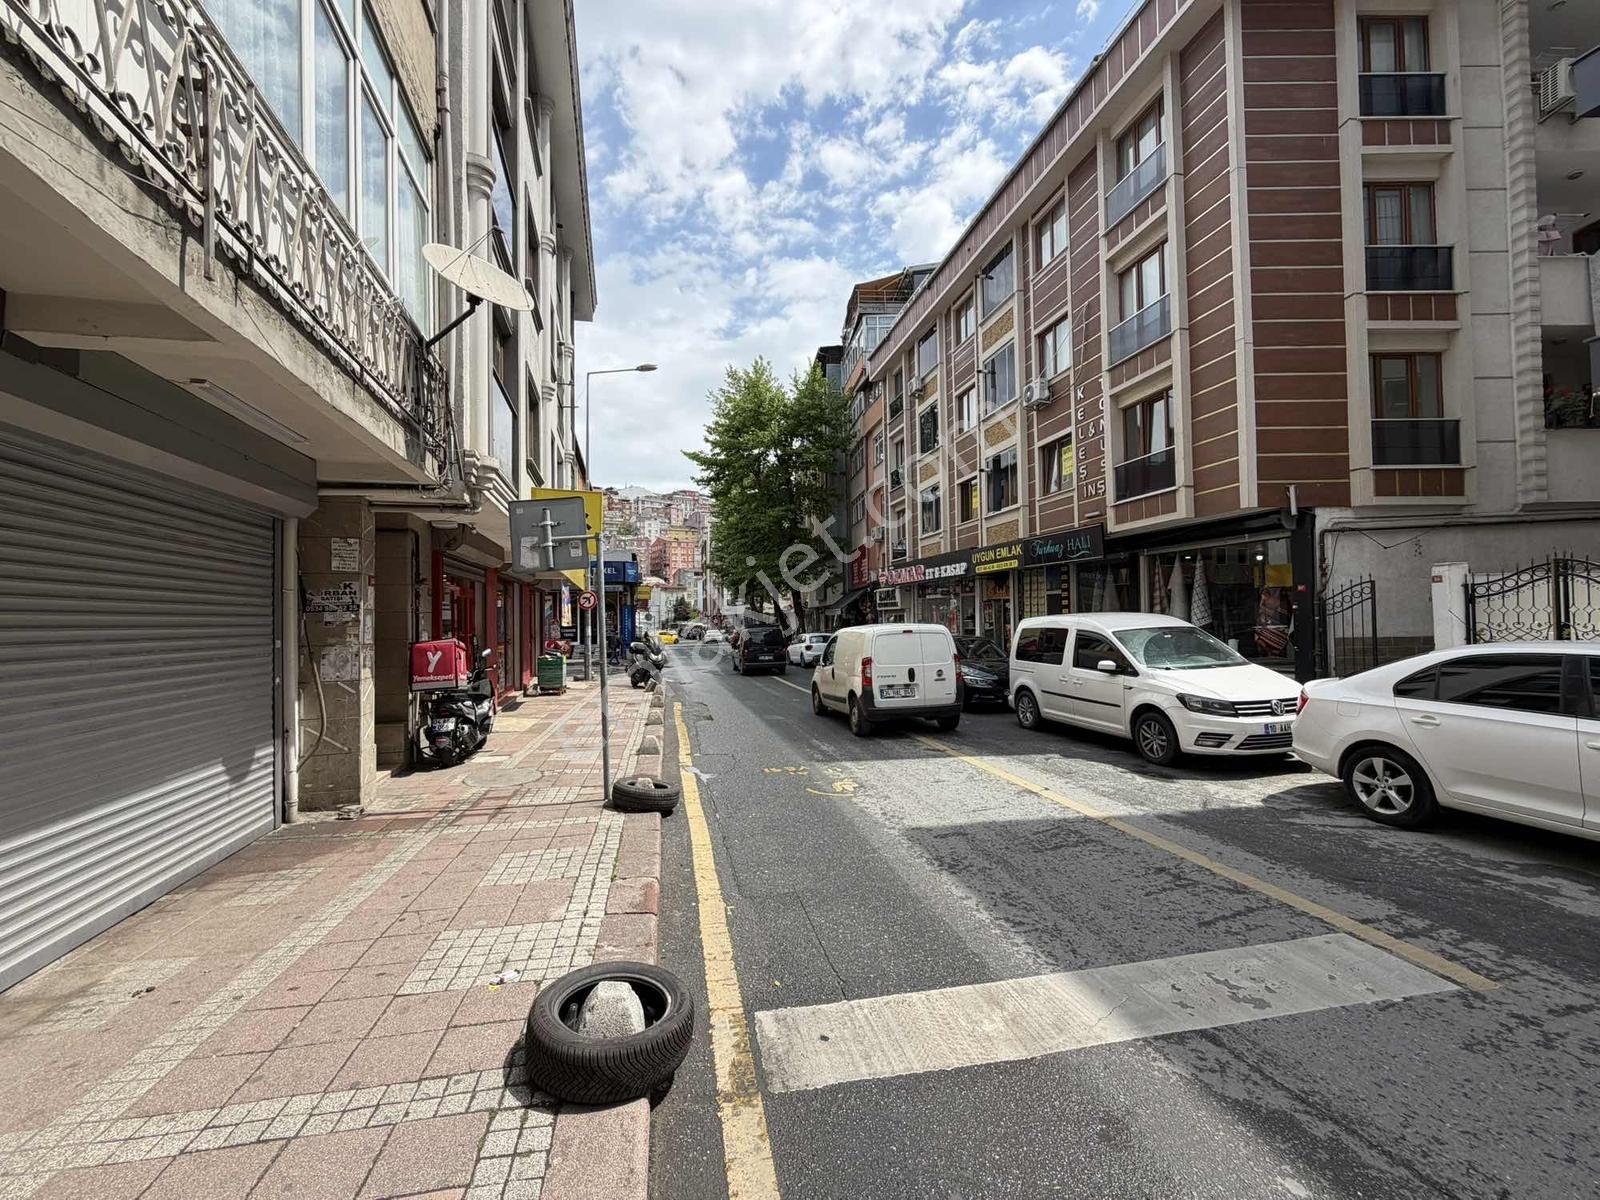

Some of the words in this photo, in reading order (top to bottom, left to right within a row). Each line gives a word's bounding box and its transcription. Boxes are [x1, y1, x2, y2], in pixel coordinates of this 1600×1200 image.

[1077, 386, 1088, 481] KELEŞ
[971, 550, 995, 564] UYGUN
[996, 544, 1023, 559] EMLAK
[941, 562, 967, 578] KASAP
[413, 674, 454, 683] Yemeksepeti
